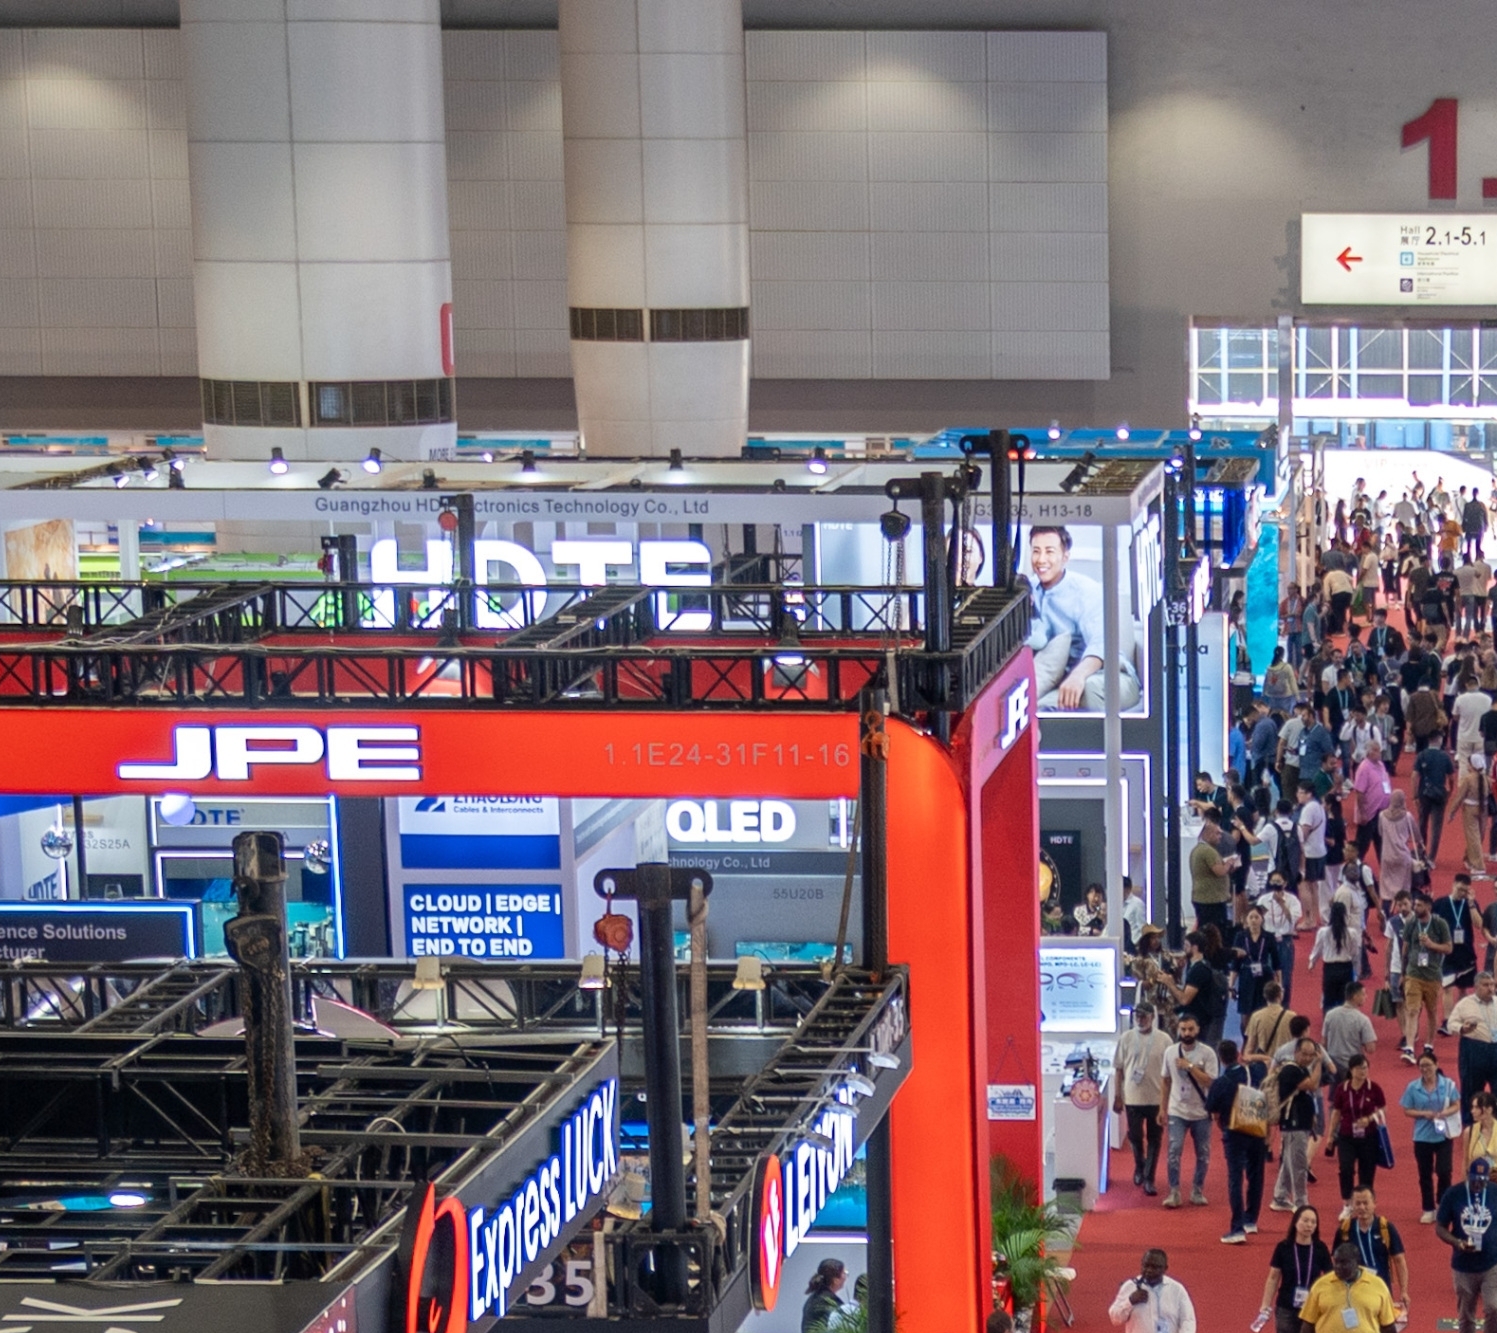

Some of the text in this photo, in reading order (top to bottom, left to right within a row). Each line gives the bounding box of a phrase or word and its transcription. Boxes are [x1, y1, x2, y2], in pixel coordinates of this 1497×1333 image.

[1400, 225, 1487, 246] Hall 2.1-5.1
[315, 497, 710, 518] Guangzhou Technology Co., Ltd
[1039, 504, 1093, 518] H13-18
[371, 539, 713, 630] HDTE
[1001, 677, 1031, 750] JPE
[116, 724, 423, 781] JPE
[605, 742, 851, 767] 1.1E24-31F11-16
[454, 806, 544, 815] Cables Interconnects
[664, 801, 796, 843] QLED
[1049, 835, 1074, 845] HDTE
[721, 856, 771, 869] Co., Ltd
[410, 893, 553, 914] CLOUD EDGE
[772, 887, 825, 900] 55U20B
[42, 923, 128, 942] Solutions
[411, 915, 513, 936] NETWORK
[412, 937, 533, 957] END TO END
